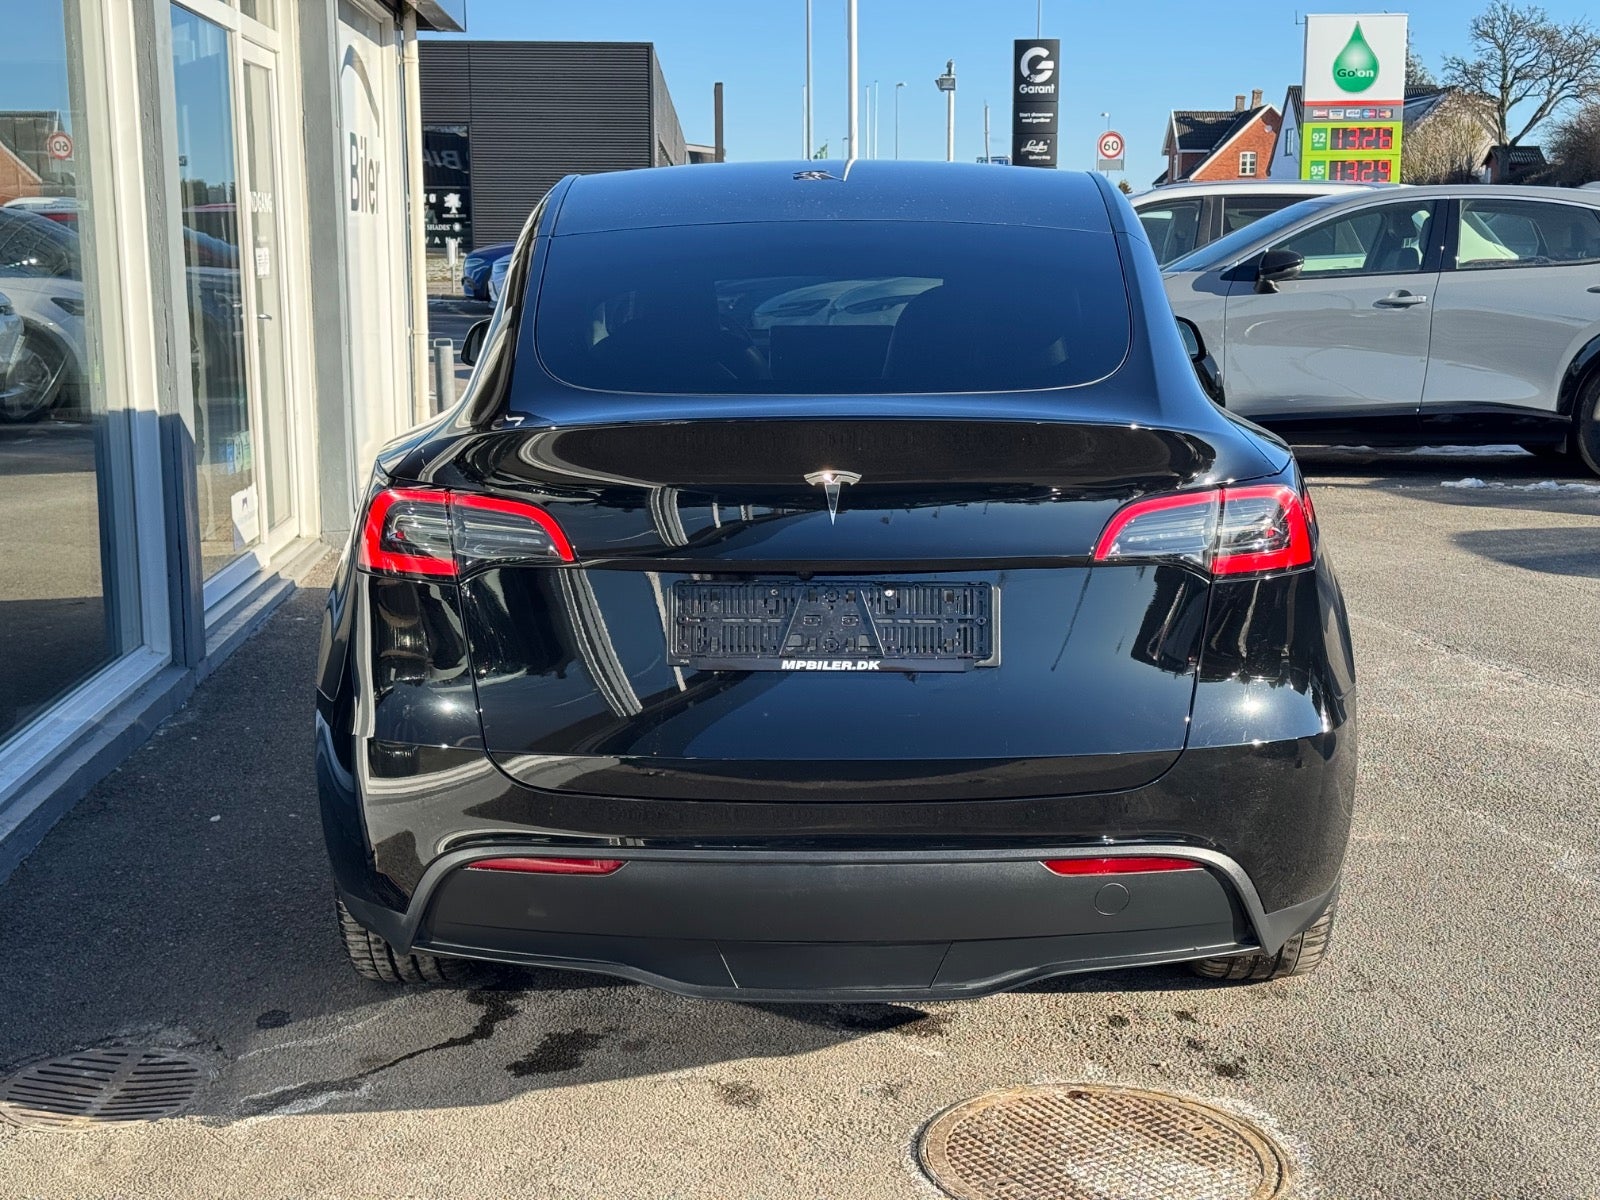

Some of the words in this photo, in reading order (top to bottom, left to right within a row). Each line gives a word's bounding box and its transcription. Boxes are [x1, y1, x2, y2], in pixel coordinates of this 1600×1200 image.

[1337, 68, 1374, 78] Go'on
[1019, 83, 1056, 94] Garant
[1312, 132, 1326, 143] 92
[1103, 140, 1119, 151] 60
[349, 132, 381, 215] Biler
[1310, 165, 1325, 176] 95
[781, 660, 881, 671] MPBILER.DK
